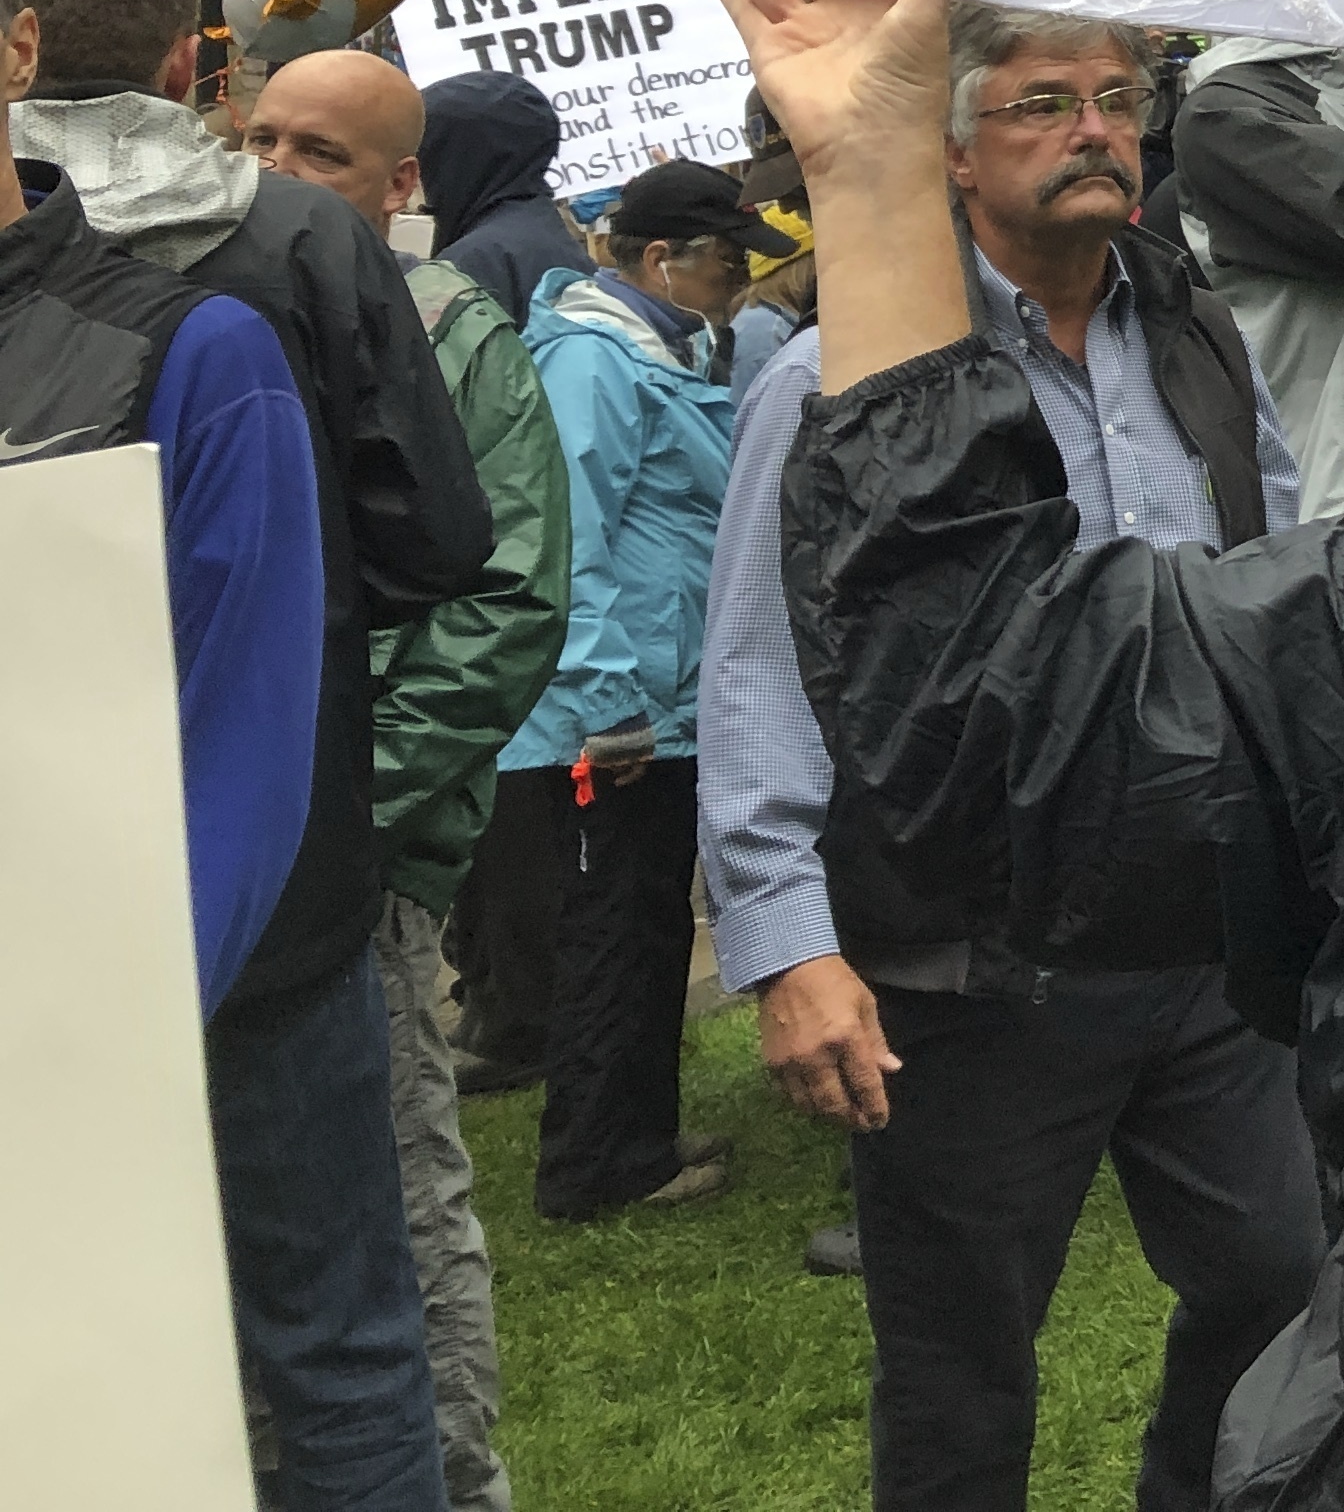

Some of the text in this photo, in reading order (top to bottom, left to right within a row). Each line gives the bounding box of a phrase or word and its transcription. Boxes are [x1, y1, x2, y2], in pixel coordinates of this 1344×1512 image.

[460, 3, 674, 77] TRUMP
[552, 84, 614, 113] our
[558, 97, 684, 143] and the
